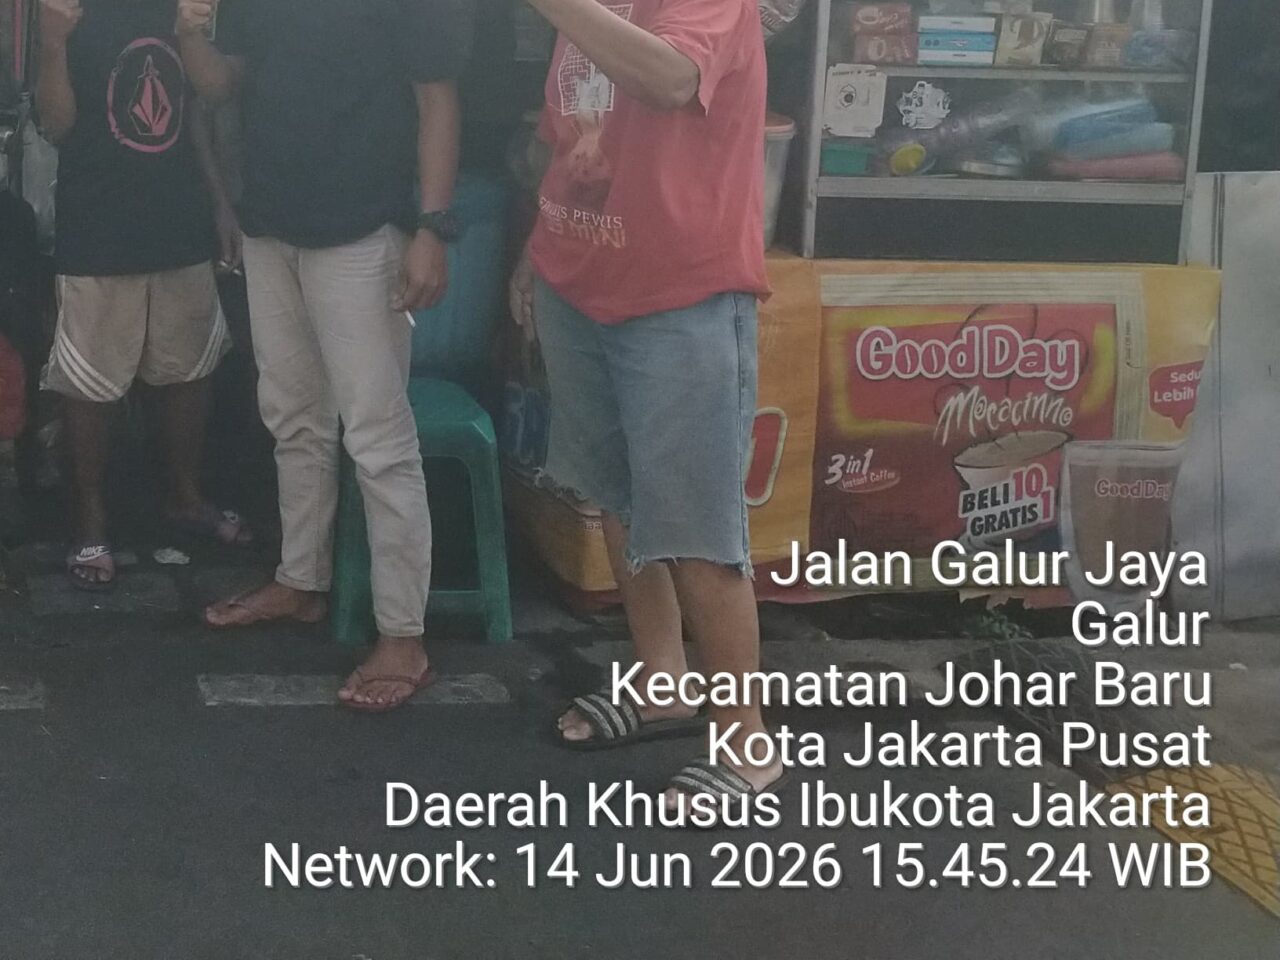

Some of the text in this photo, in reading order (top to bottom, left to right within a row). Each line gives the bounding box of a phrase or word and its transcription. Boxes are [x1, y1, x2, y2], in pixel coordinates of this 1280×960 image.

[856, 325, 980, 380] Good
[981, 324, 1079, 390] Day
[933, 385, 1073, 446] Mocacinno
[1153, 386, 1195, 404] Lebih
[961, 467, 1045, 515] BELI 10
[1095, 479, 1143, 498] Good
[970, 503, 1039, 537] GRATIS
